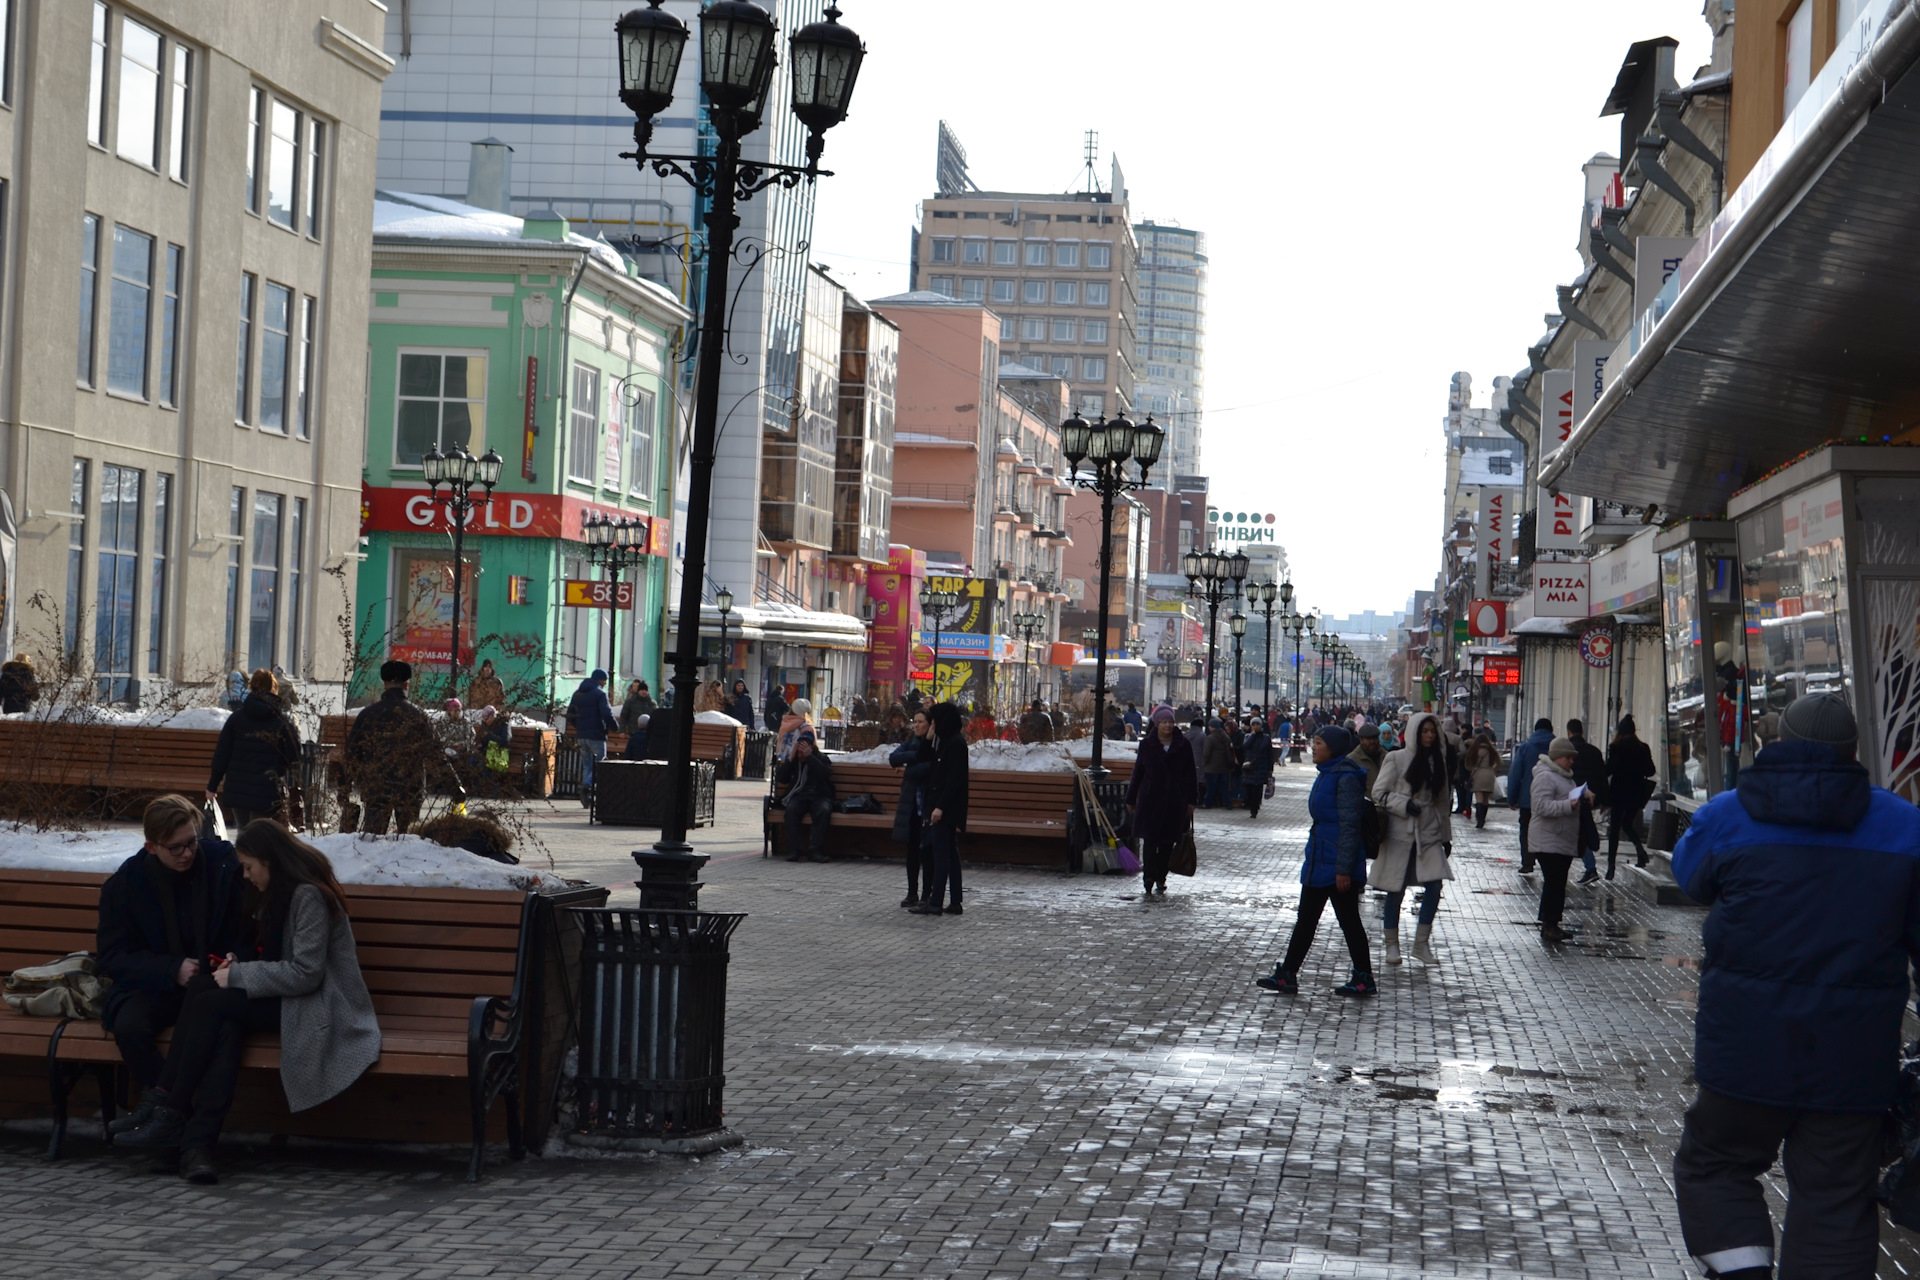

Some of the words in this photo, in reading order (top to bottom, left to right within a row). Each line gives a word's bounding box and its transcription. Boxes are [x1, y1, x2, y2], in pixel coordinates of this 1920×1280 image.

[405, 495, 535, 529] GOLD
[1489, 493, 1503, 528] MIA
[888, 556, 904, 566] elry
[931, 576, 965, 593] БАР
[1539, 577, 1585, 589] PIZZA
[592, 583, 630, 603] 585
[1546, 591, 1579, 602] MIA
[961, 599, 981, 632] KILLFISH
[919, 636, 936, 645] ЫЙ
[940, 637, 985, 647] МАГАЗИН
[1582, 628, 1612, 645] STARCU
[1584, 653, 1612, 666] COFFE
